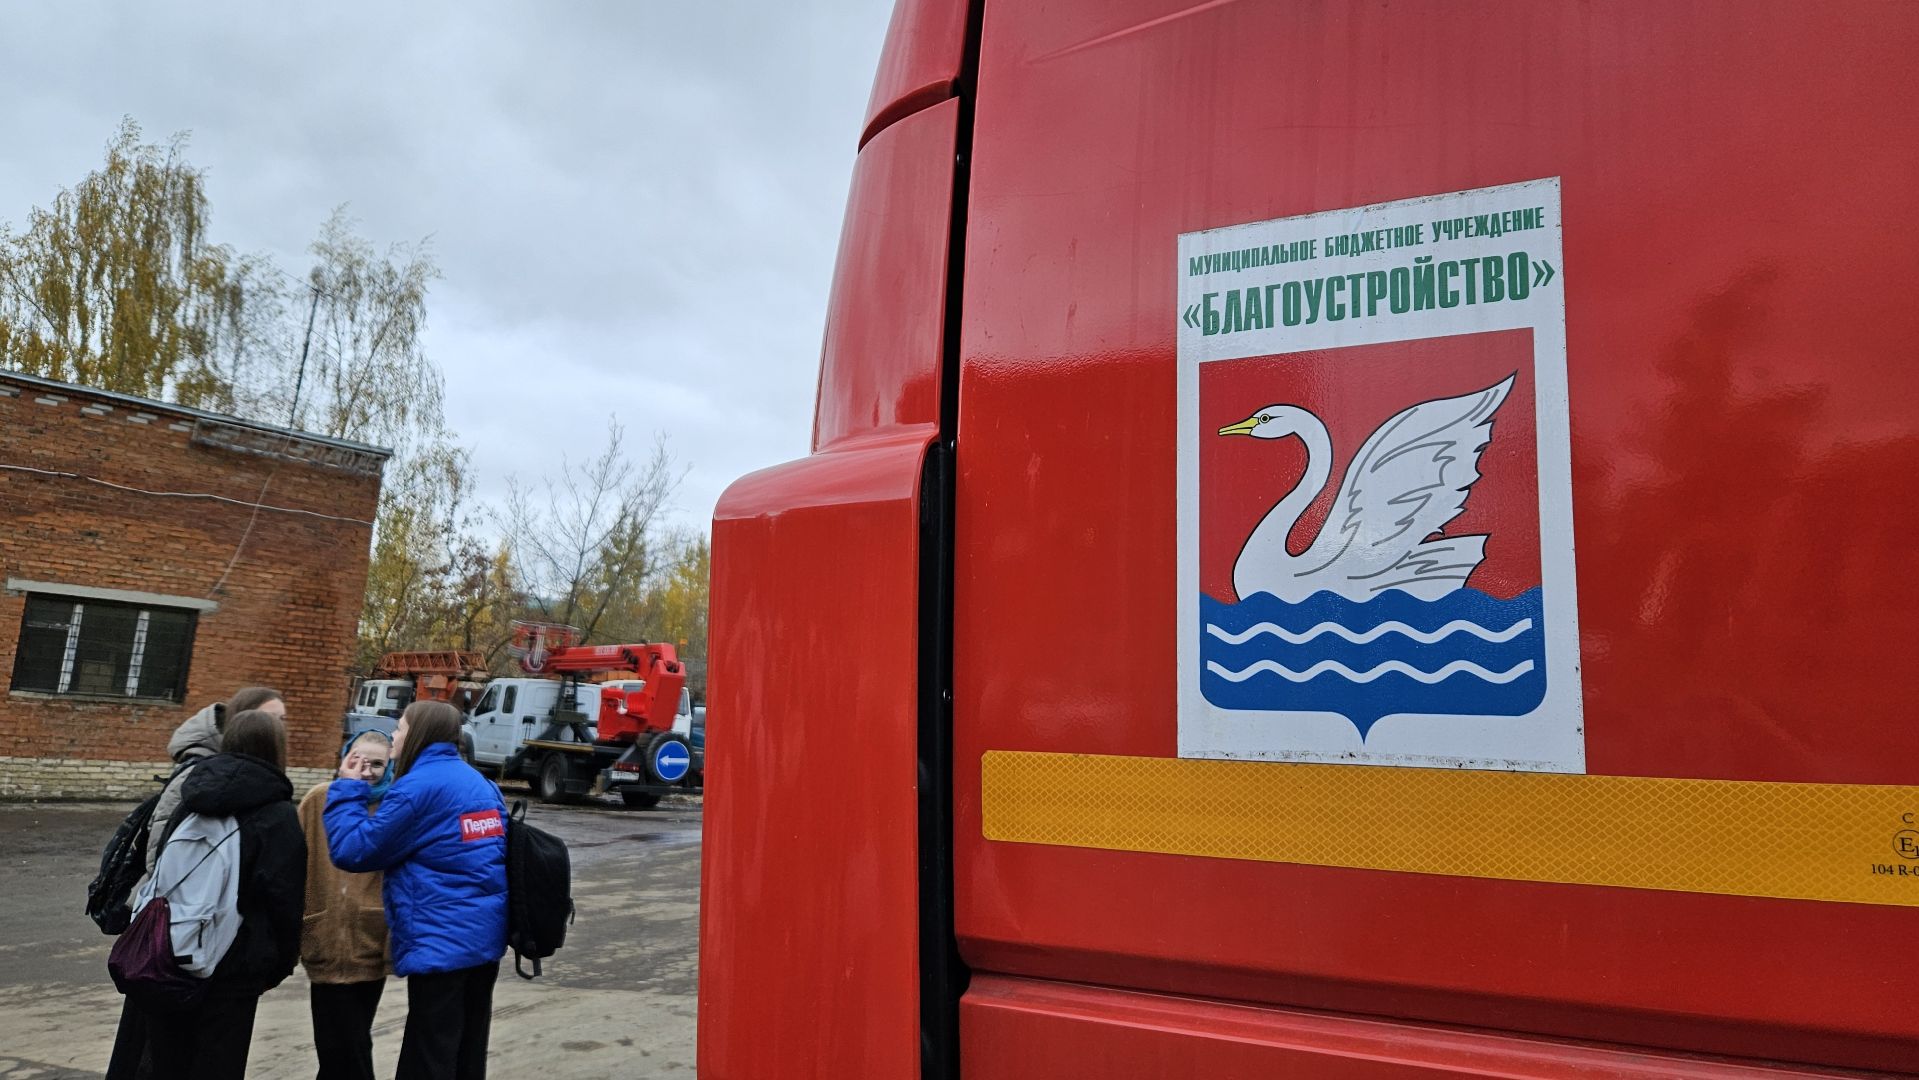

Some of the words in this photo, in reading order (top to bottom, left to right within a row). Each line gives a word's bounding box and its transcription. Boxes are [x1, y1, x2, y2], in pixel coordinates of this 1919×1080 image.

[1189, 239, 1318, 277] МУНИЦИПАЛЬНОЕ
[1324, 223, 1424, 258] БЮДЖЕТНОЕ
[1431, 206, 1545, 244] УЧРЕЖДЕНИЕ
[1182, 251, 1555, 337] «БЛАГОУСТРОЙСТВО»
[1901, 812, 1914, 824] C
[1872, 863, 1894, 875] 104
